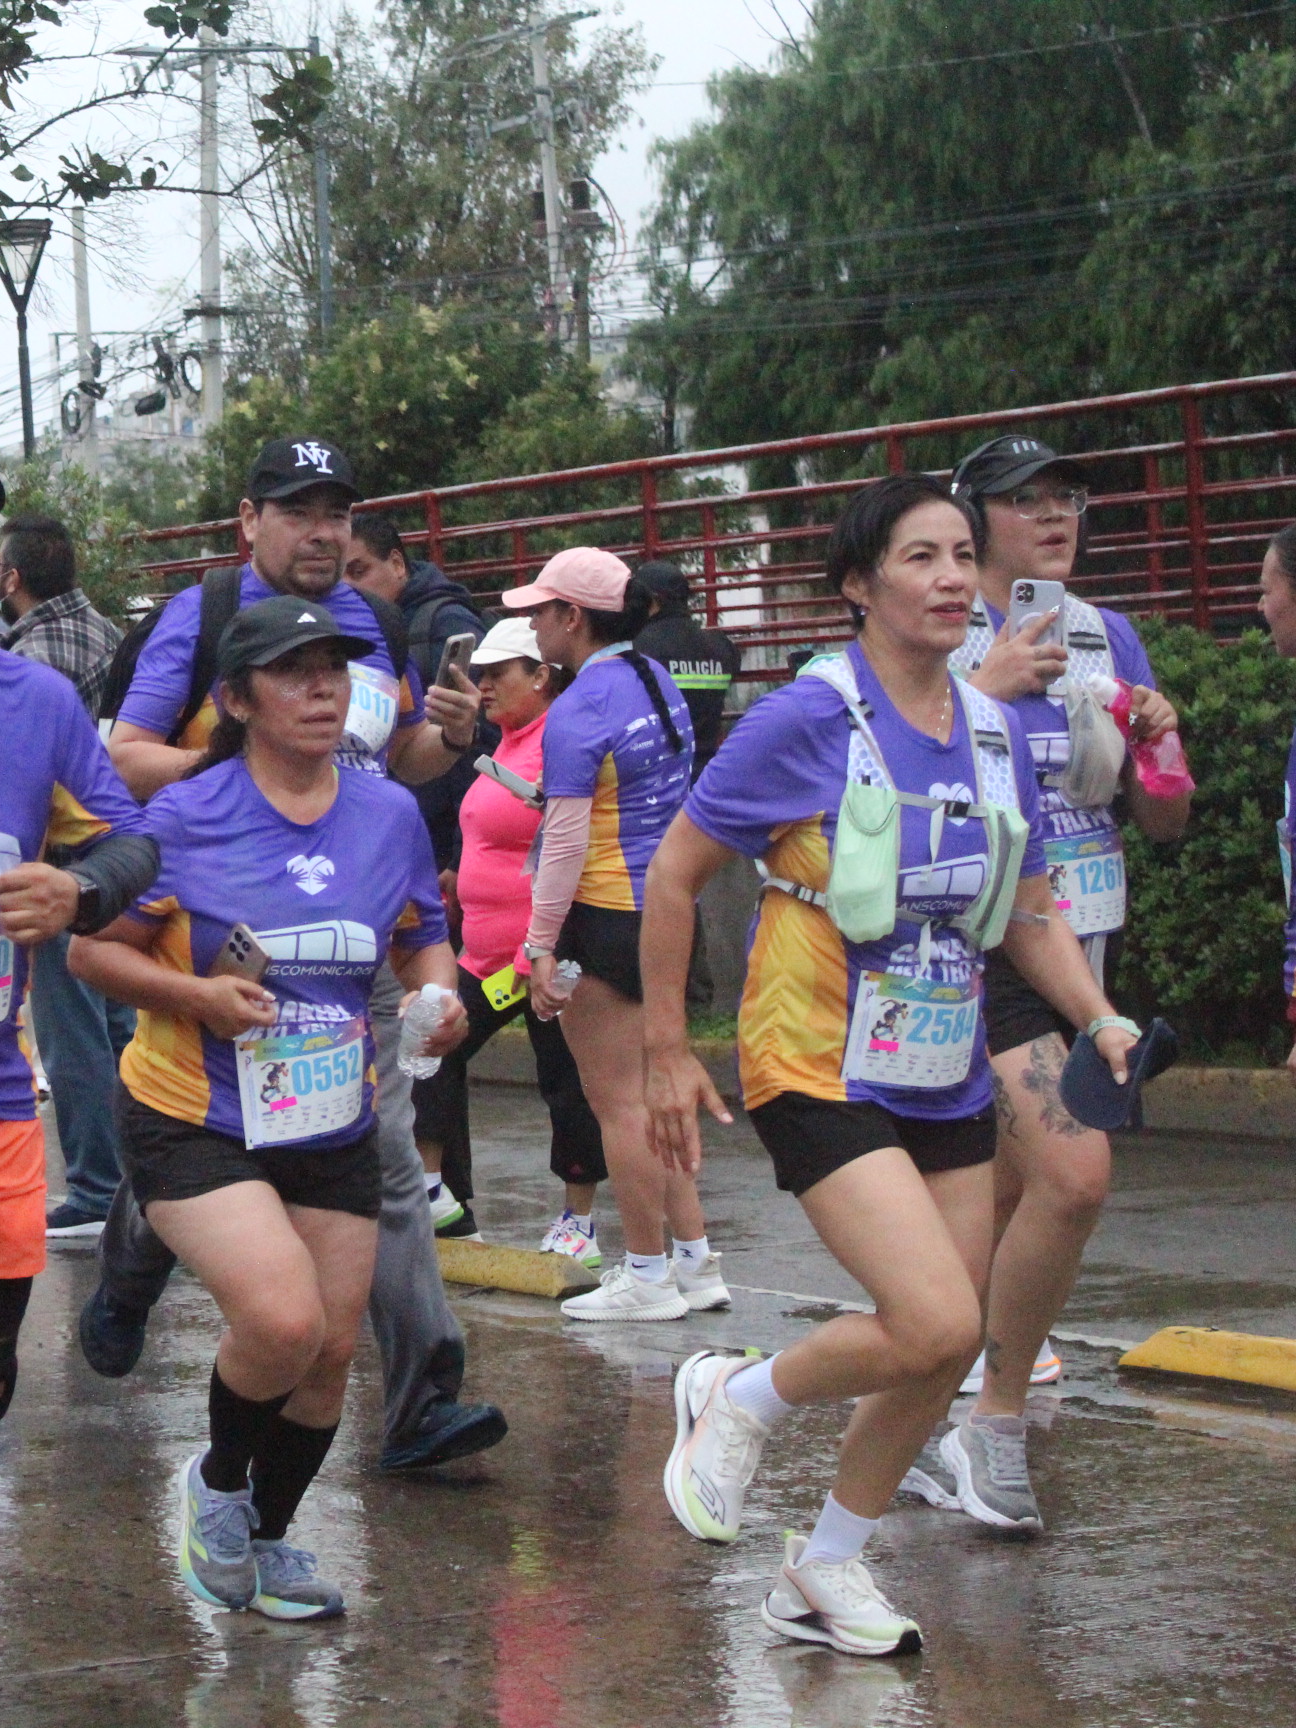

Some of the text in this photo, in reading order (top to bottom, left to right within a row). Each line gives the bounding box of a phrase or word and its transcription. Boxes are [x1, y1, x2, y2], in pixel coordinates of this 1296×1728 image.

[292, 442, 333, 474] NY
[669, 659, 723, 675] POLICÍA
[1073, 857, 1123, 896] 1261
[905, 1003, 977, 1046] 2584
[290, 1044, 361, 1097] 0552
